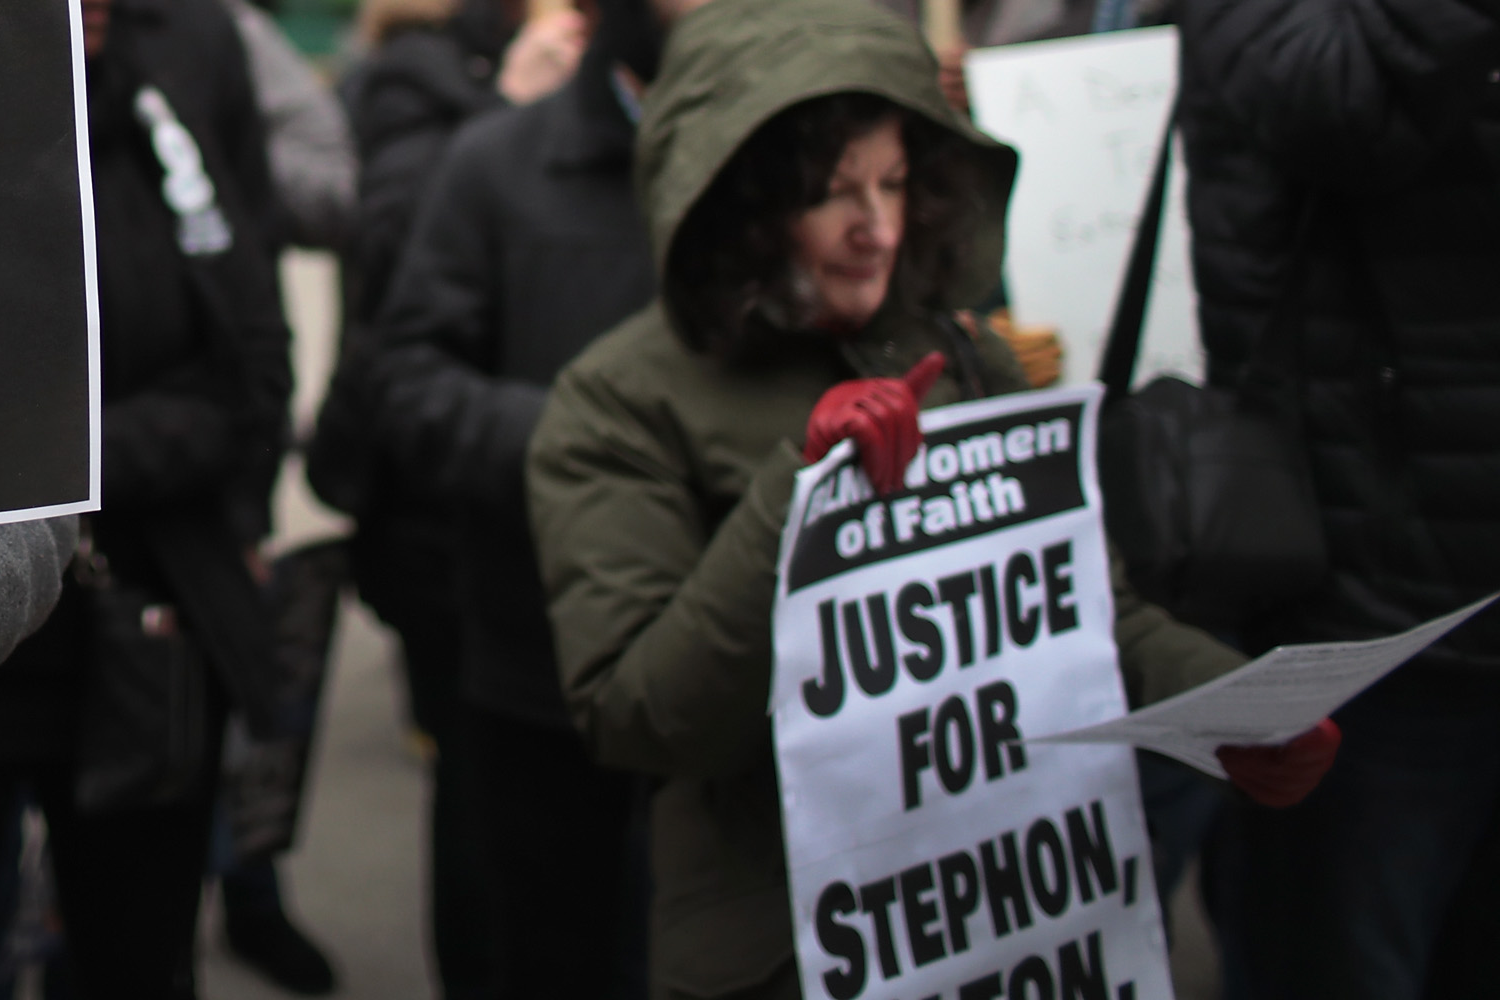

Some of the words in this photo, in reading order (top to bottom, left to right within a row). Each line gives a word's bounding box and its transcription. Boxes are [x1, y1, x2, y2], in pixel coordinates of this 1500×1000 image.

[835, 501, 885, 560] of
[890, 474, 1025, 543] Faith
[800, 540, 1081, 718] JUSTICE
[897, 679, 1028, 812] FOR
[814, 799, 1138, 1000] STEPHON,
